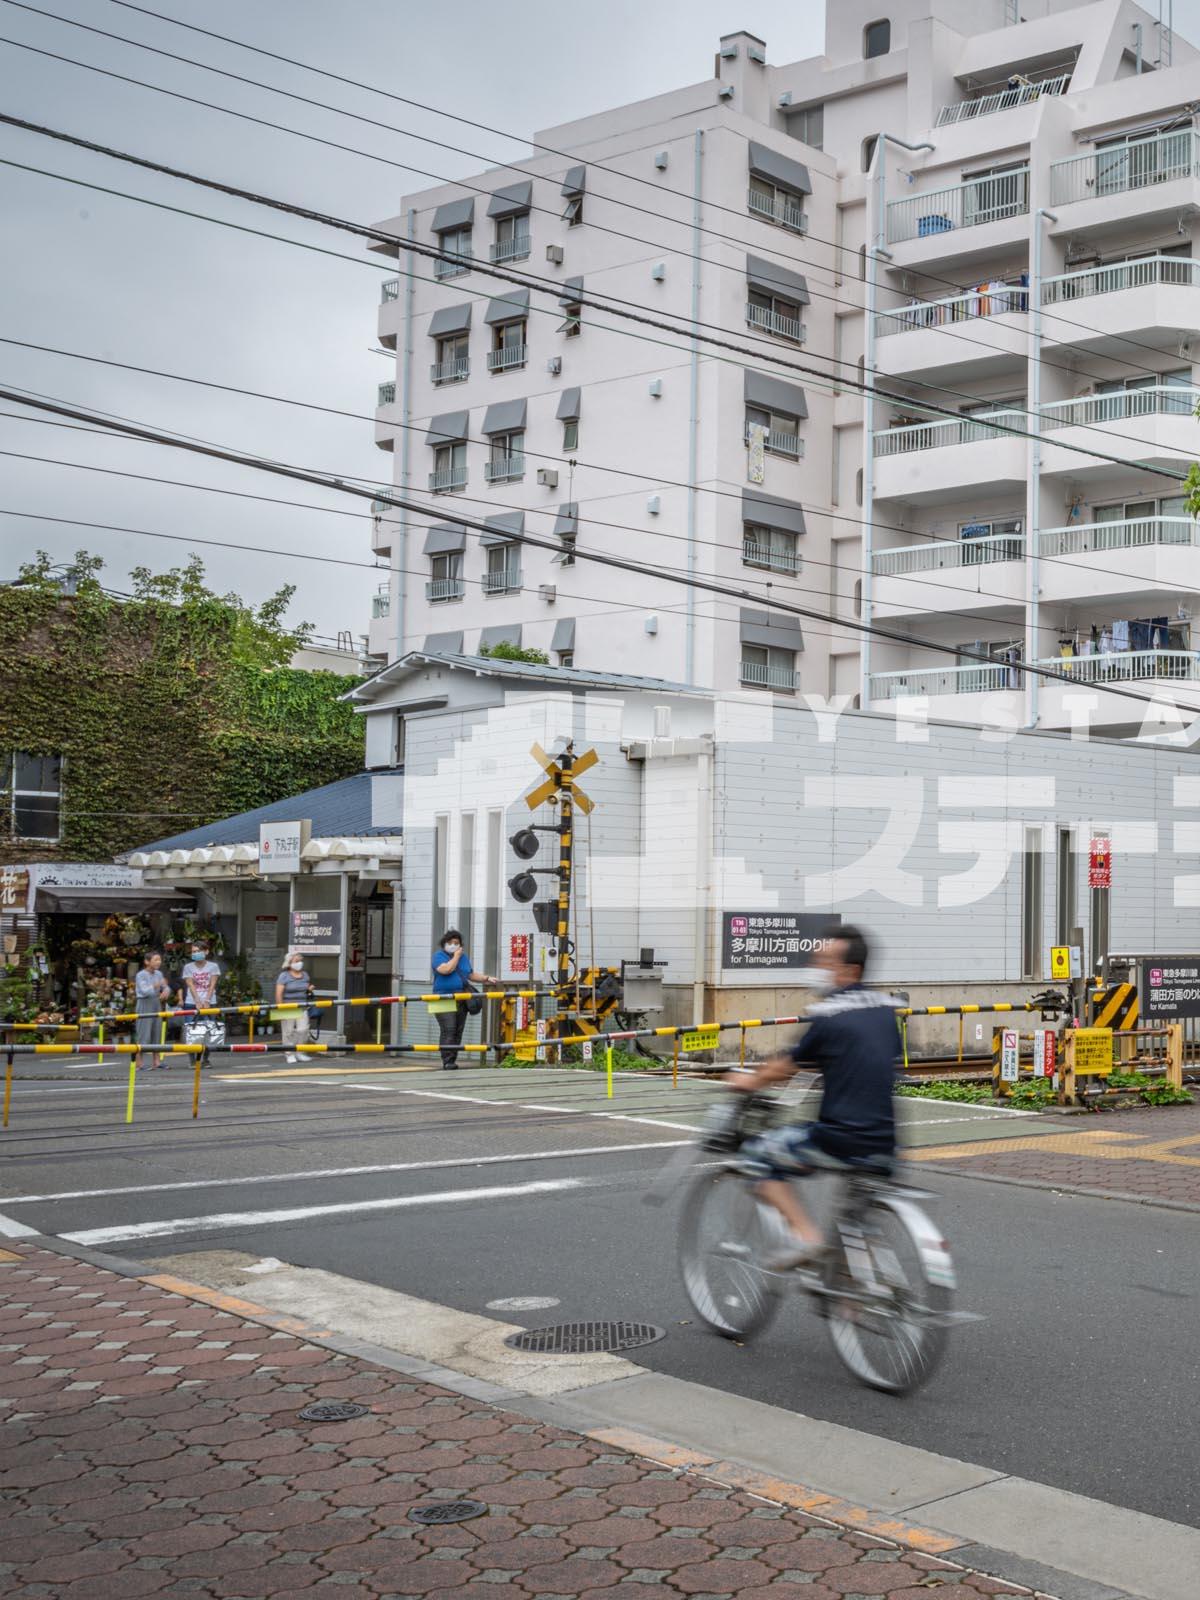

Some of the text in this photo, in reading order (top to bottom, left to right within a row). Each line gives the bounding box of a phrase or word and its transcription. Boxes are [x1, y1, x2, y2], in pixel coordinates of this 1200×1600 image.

[748, 917, 797, 928] 東急多摩川線
[731, 954, 788, 966] for Tamagawa
[1158, 1002, 1178, 1010] Kamata
